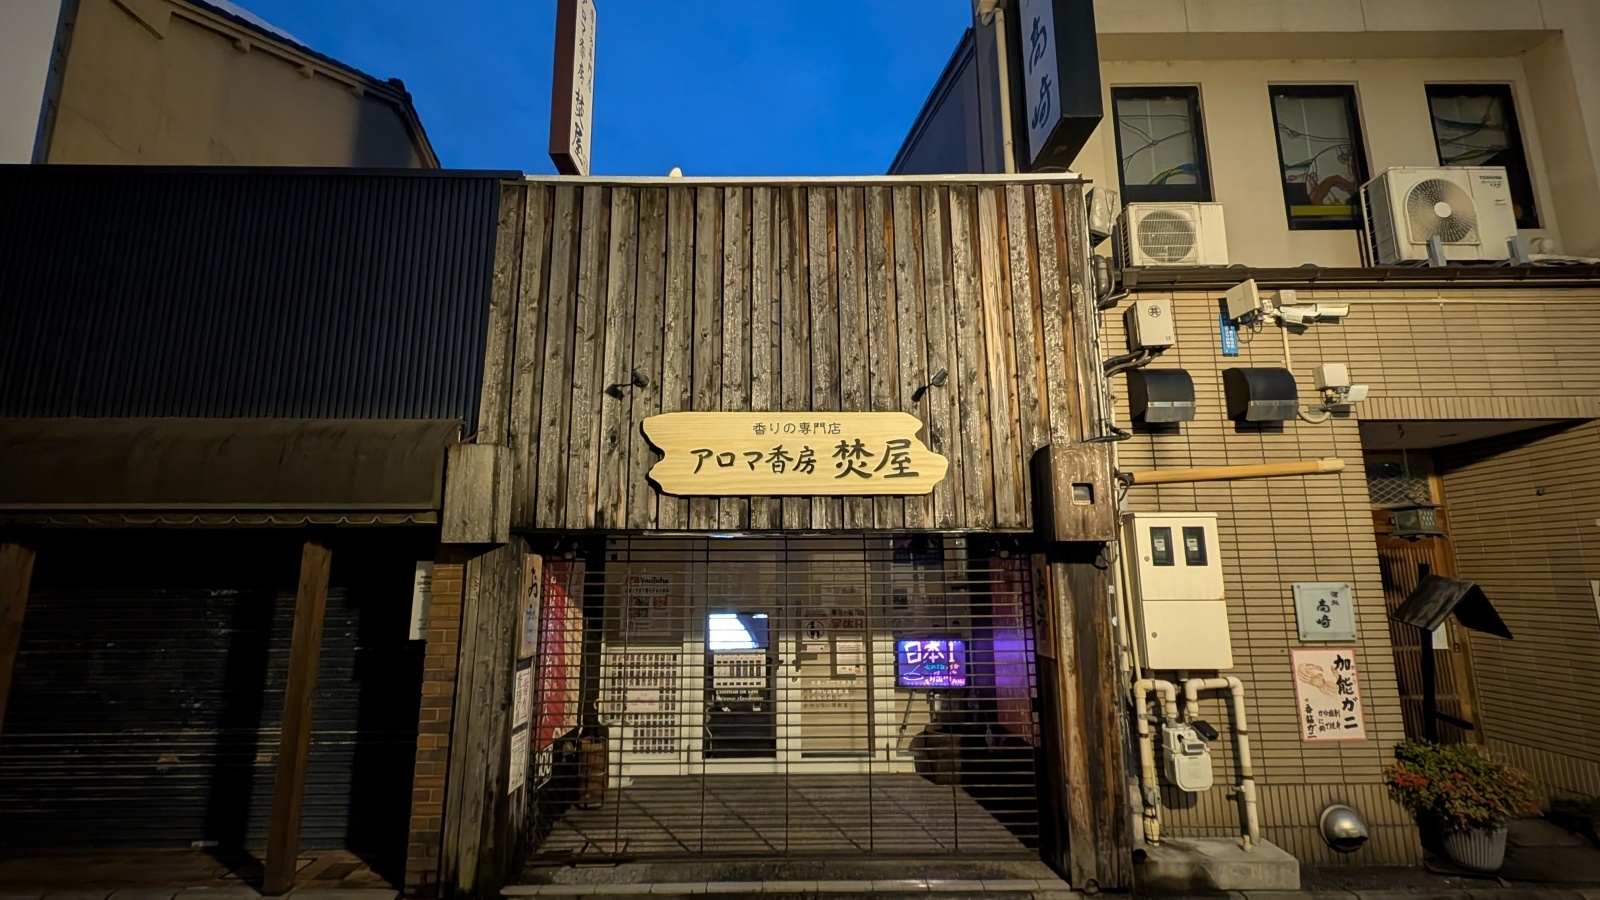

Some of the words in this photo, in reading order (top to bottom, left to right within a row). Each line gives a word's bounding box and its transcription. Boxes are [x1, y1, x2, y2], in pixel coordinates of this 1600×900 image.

[1149, 306, 1160, 317] 共
[752, 421, 841, 435] 香りの専門店
[690, 444, 817, 475] アロマ香房
[831, 438, 920, 479] 焚屋
[832, 617, 863, 629] 定休日
[1334, 654, 1359, 729] 加能ガニ
